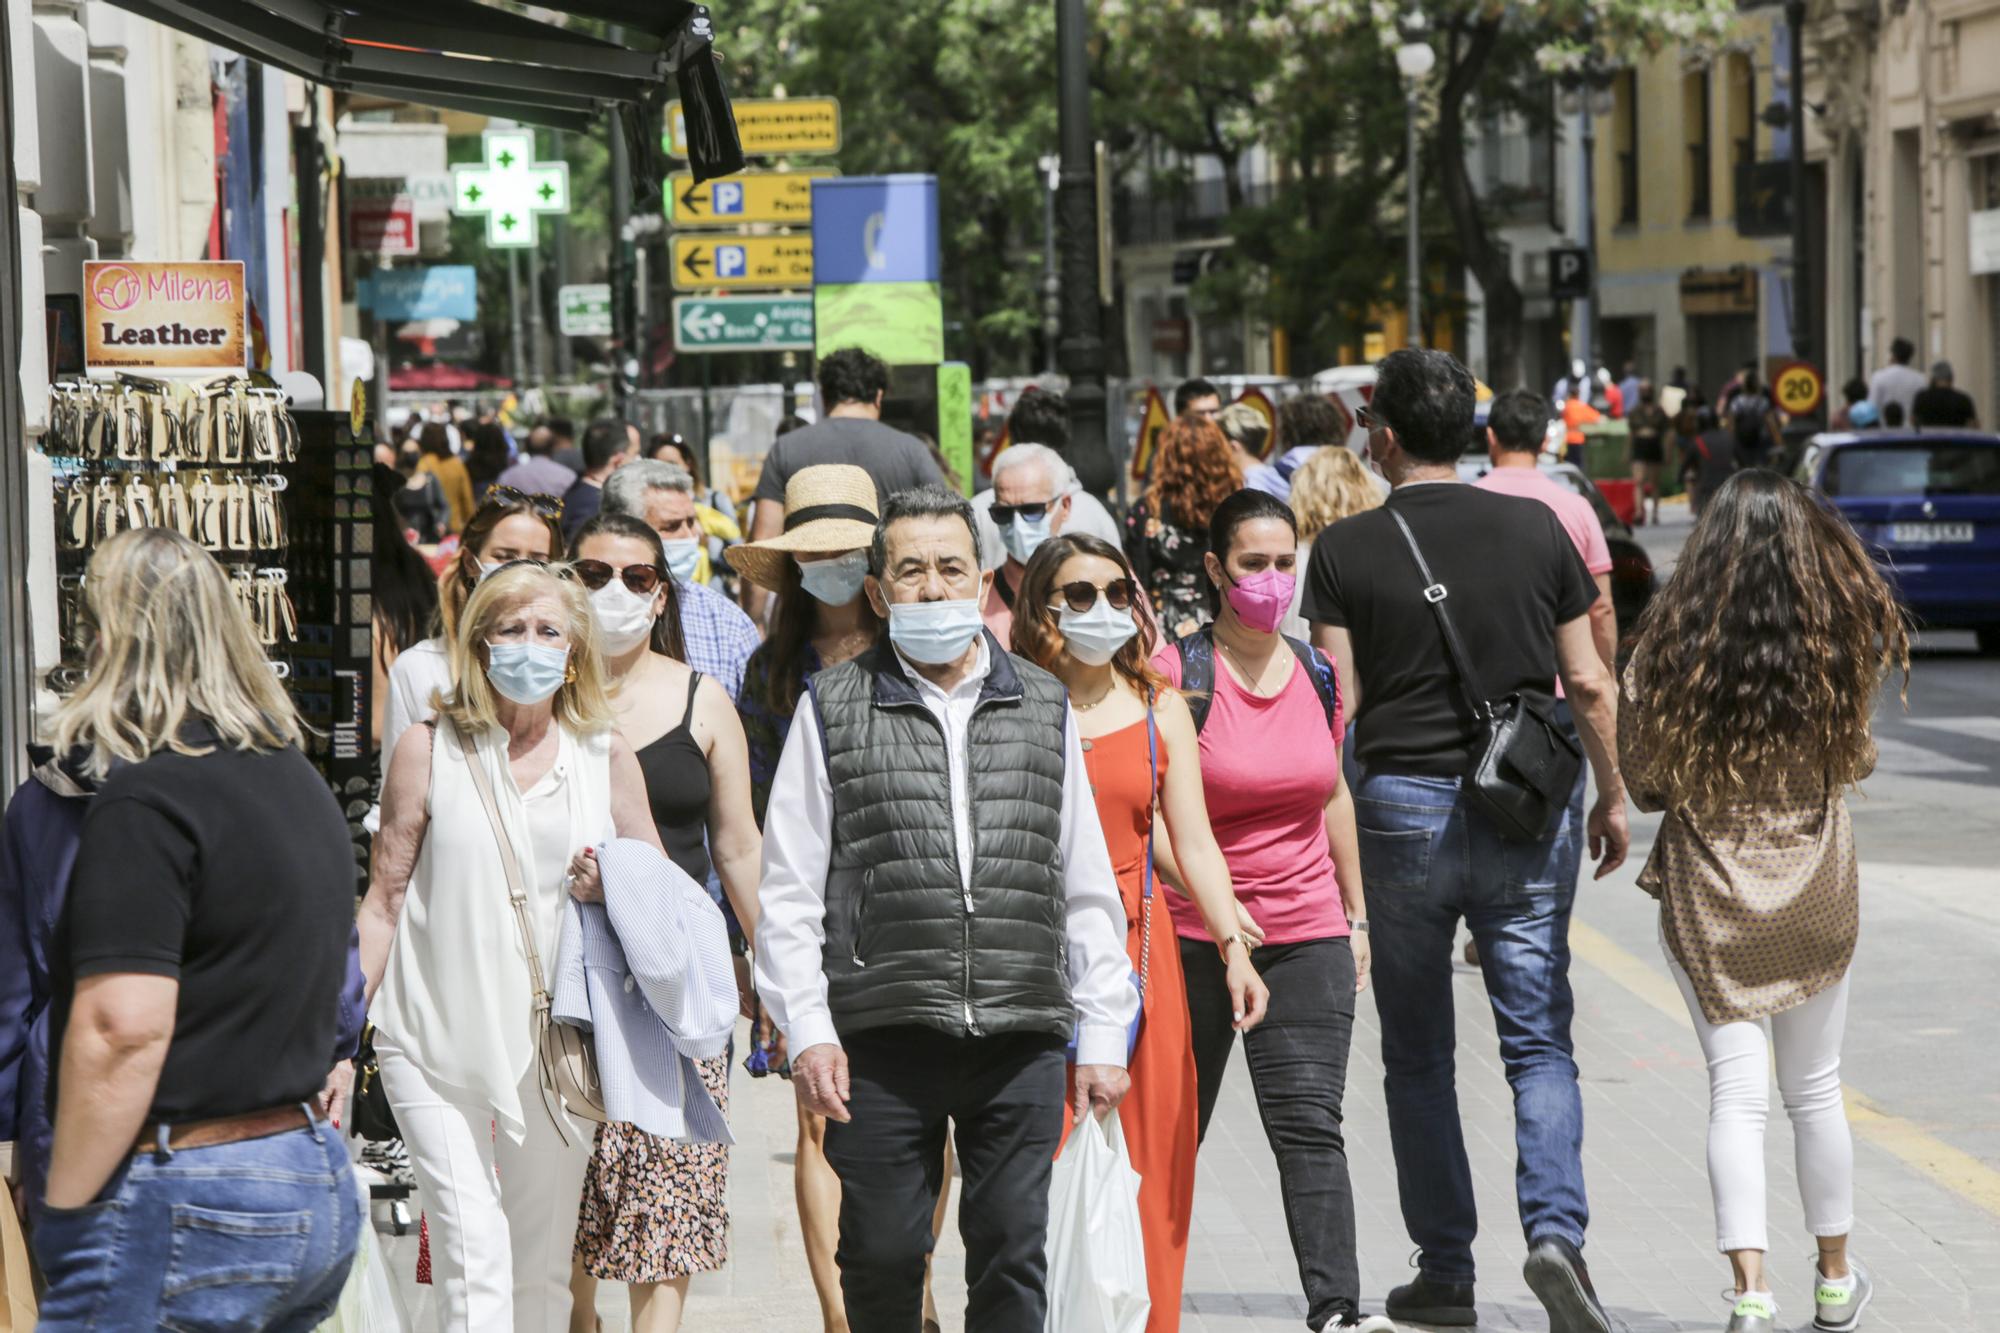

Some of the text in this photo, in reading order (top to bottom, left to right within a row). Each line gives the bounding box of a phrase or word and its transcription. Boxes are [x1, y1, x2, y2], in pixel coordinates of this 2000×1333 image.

[717, 183, 741, 213] P
[719, 246, 743, 277] P
[1559, 255, 1579, 282] P
[147, 271, 233, 303] Milena
[102, 322, 226, 345] Leather
[1785, 378, 1813, 400] 20
